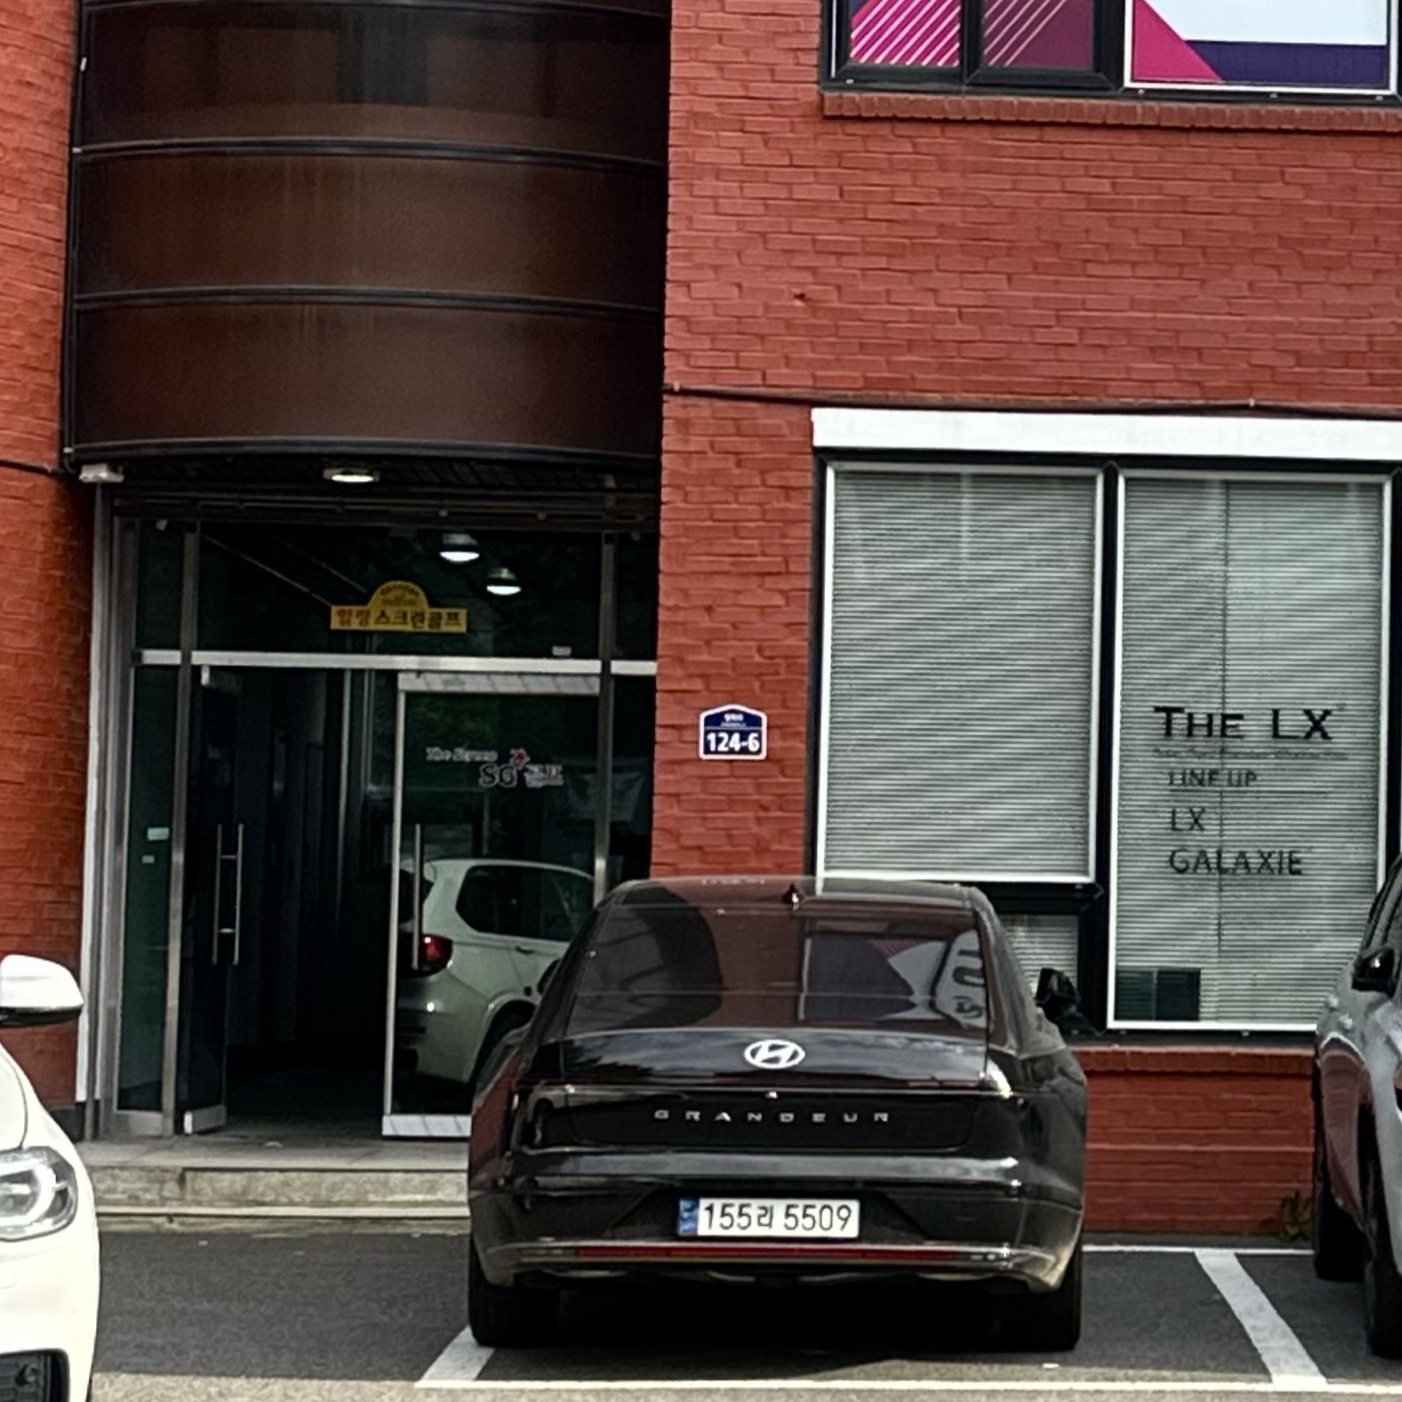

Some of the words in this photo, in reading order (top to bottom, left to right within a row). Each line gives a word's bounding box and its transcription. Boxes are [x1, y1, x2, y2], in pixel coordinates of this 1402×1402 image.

[1153, 706, 1244, 738] THE
[706, 732, 760, 752] 124-6
[1170, 807, 1206, 832] LX
[1169, 849, 1302, 875] GALAXIE
[654, 1109, 889, 1123] GRANDEUR
[783, 1204, 852, 1232] 5509
